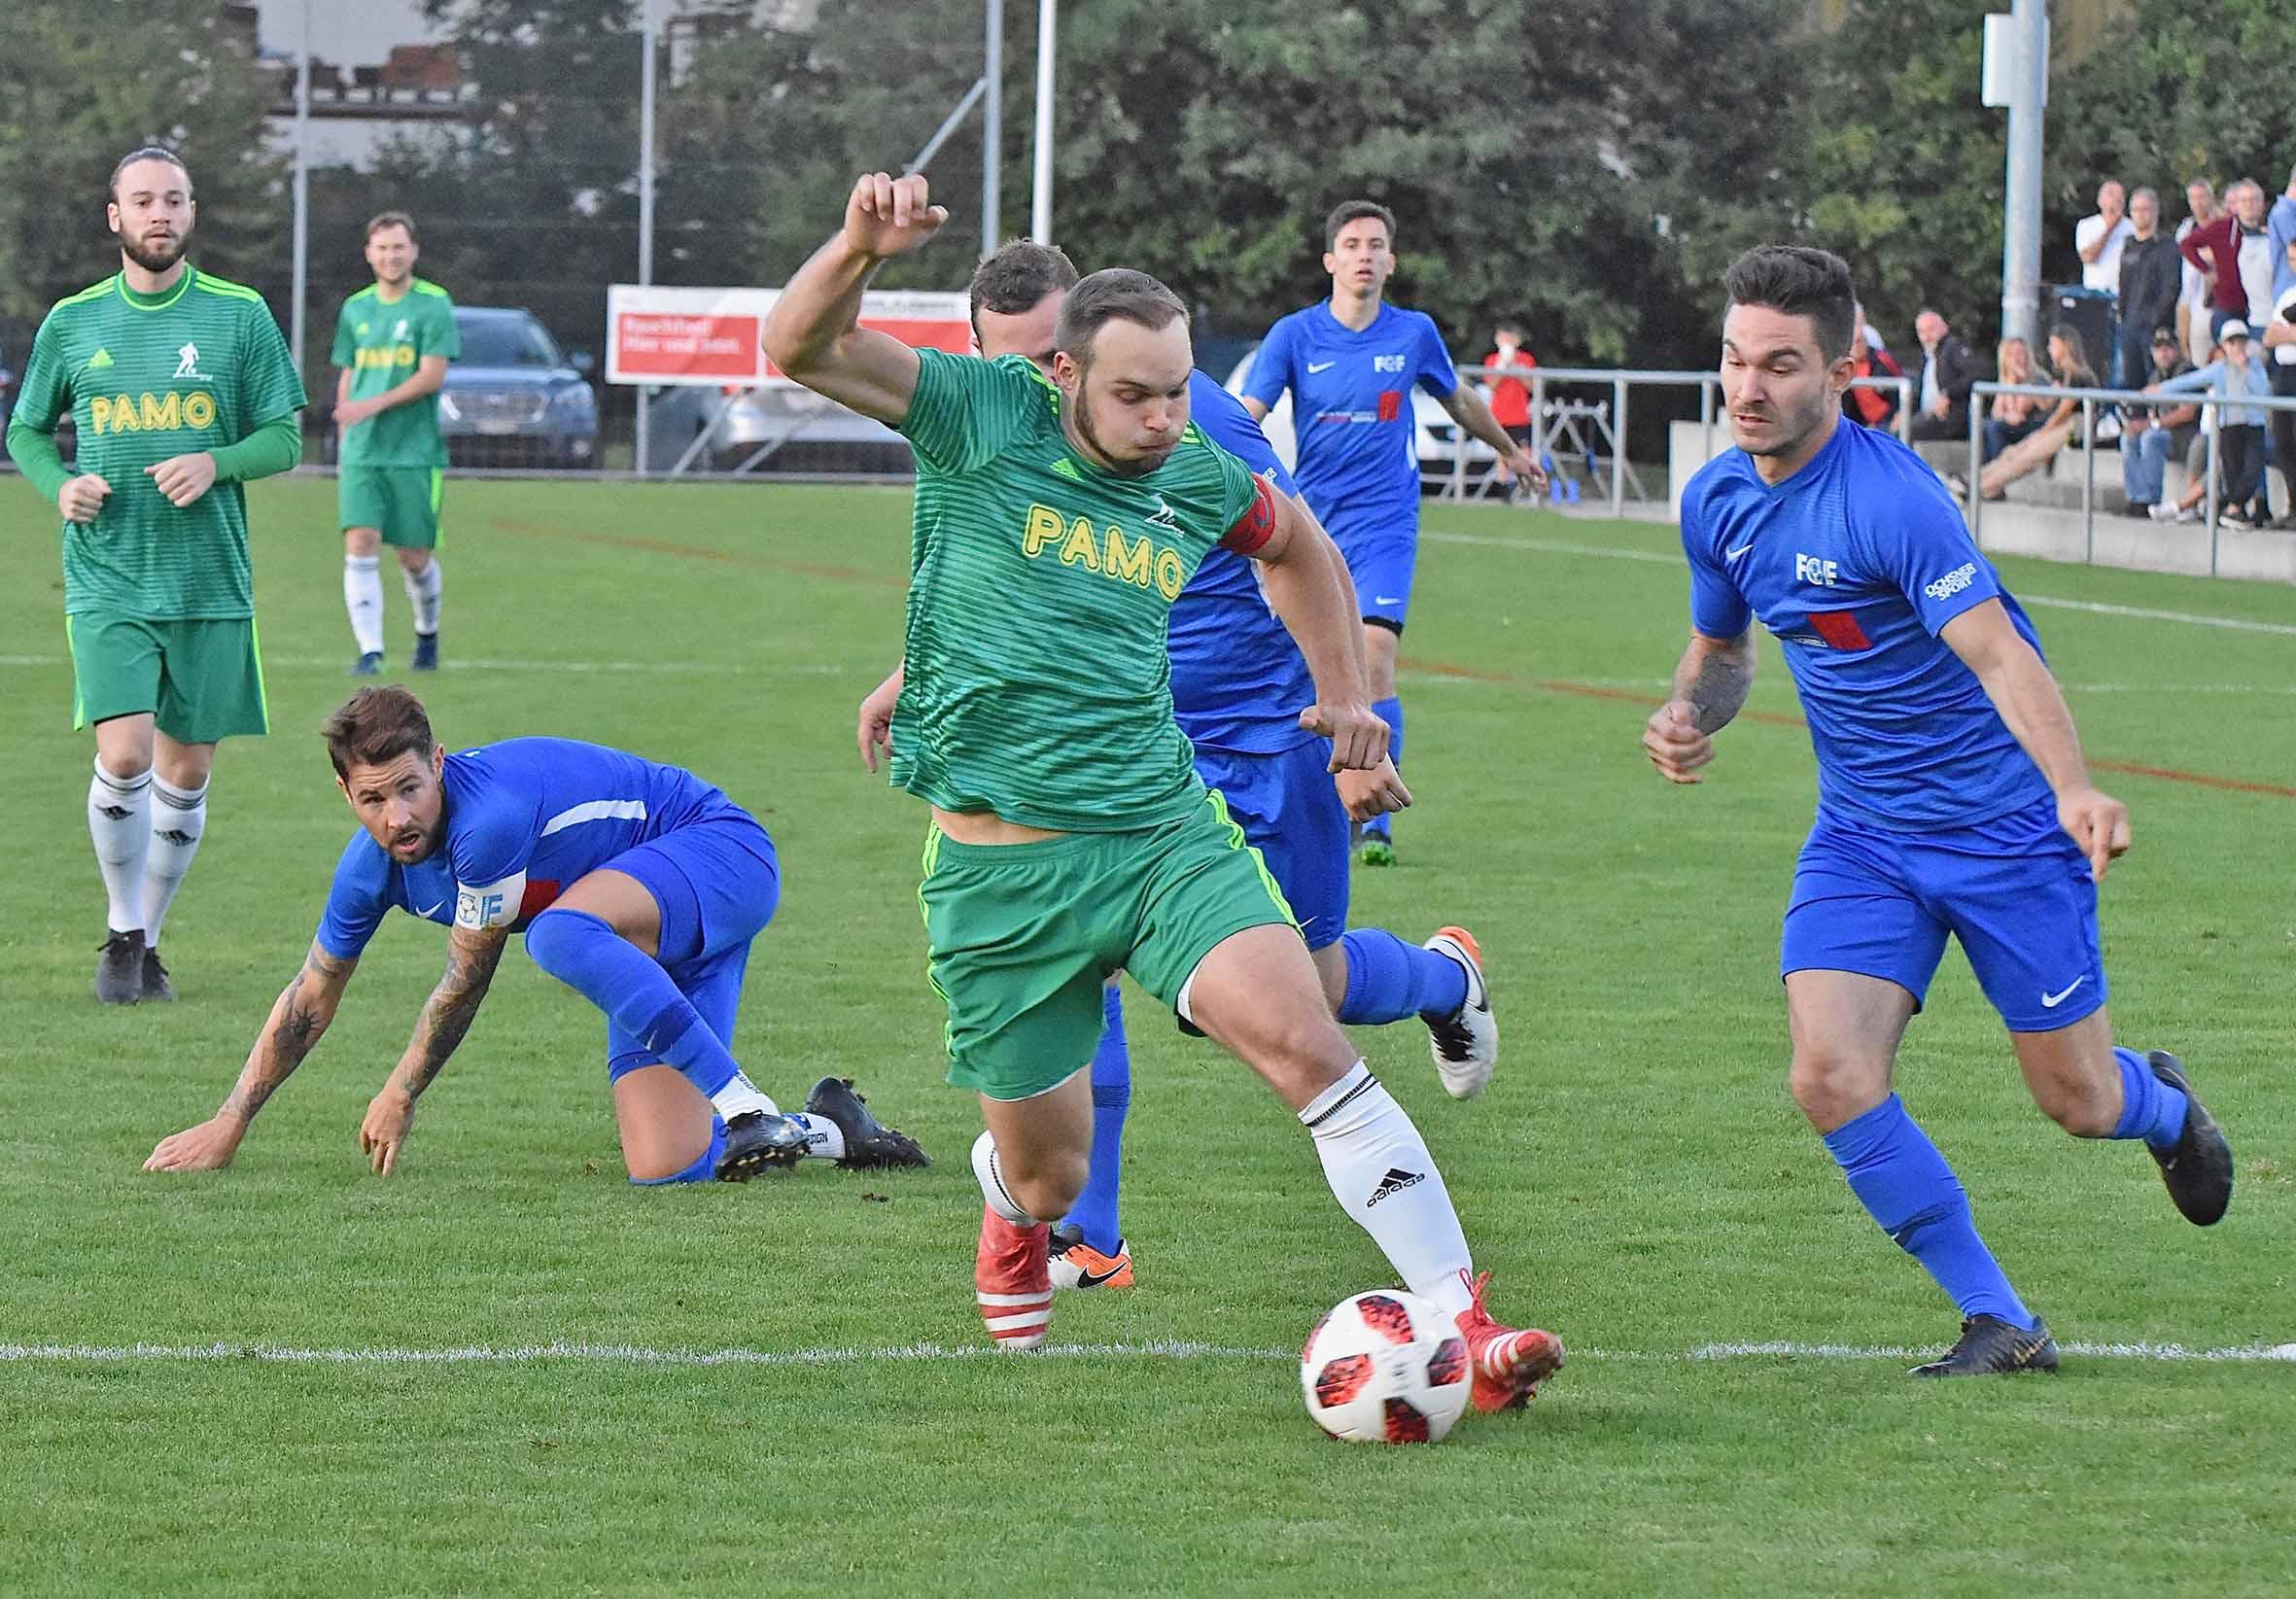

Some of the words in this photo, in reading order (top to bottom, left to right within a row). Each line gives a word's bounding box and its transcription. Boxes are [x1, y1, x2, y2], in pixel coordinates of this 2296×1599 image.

[90, 391, 216, 435] PAMO
[1022, 503, 1184, 593] PAMO
[1924, 562, 1978, 599] OCHSNER
[1936, 574, 1973, 602] SPORT
[1366, 1172, 1426, 1208] adidas
